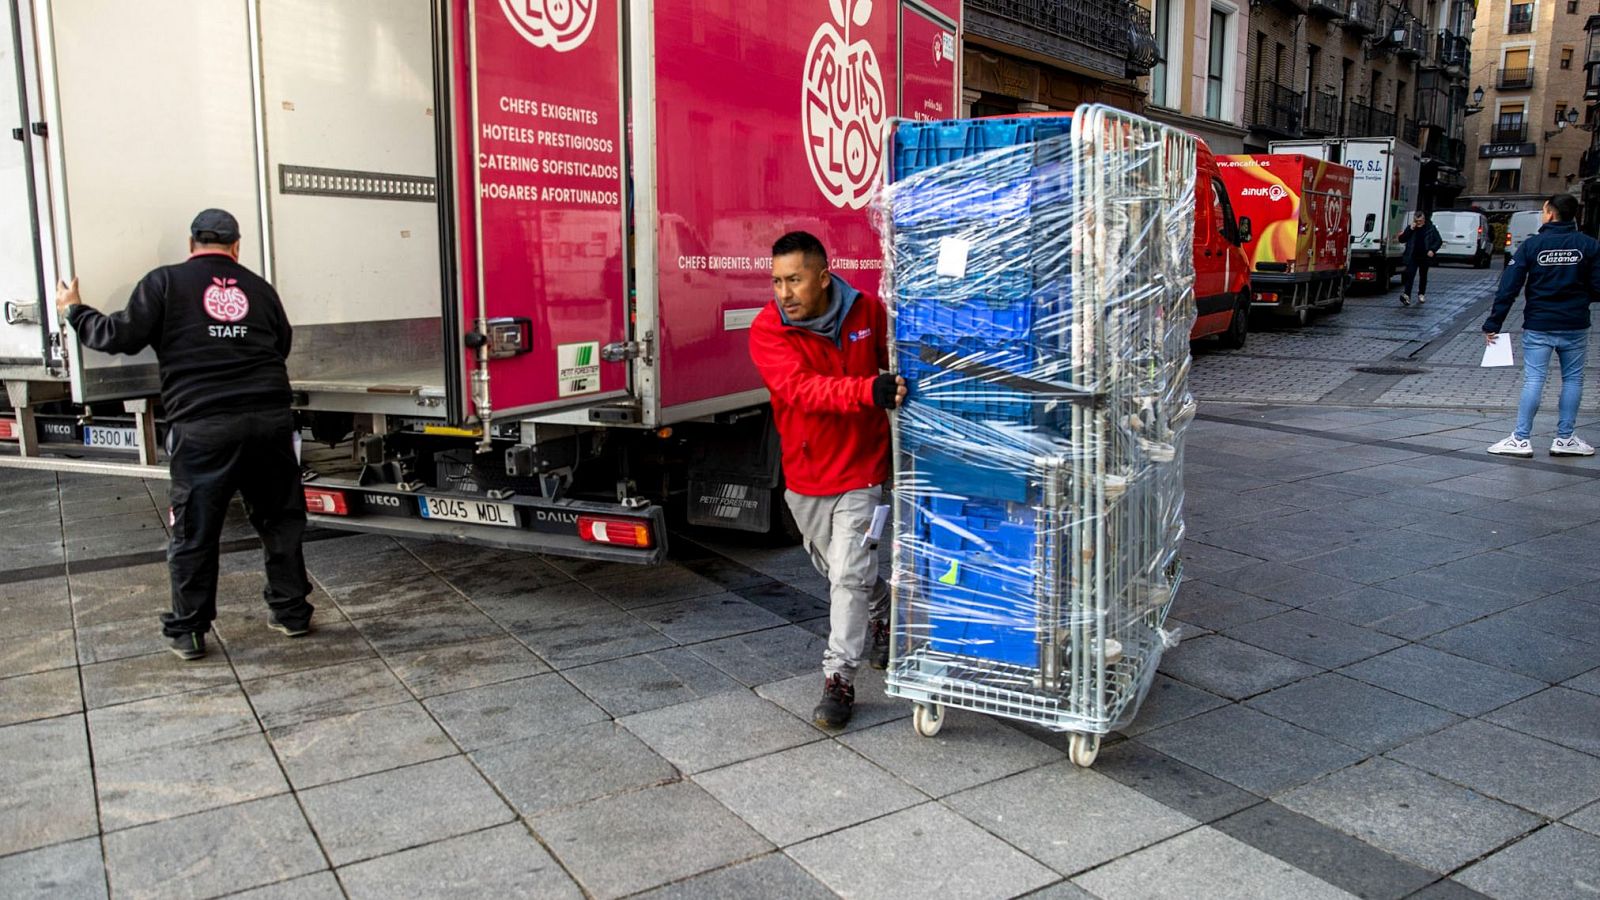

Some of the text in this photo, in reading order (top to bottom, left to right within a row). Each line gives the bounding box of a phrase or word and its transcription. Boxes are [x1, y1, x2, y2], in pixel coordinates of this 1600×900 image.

[807, 33, 883, 130] FRUTAS
[499, 96, 598, 125] CHEFS EXIGENTES
[482, 123, 613, 153] HOTELES PRESTIGIOSOS
[806, 86, 884, 199] ELOY
[479, 152, 619, 179] CATERING SOFISTICADOS
[1367, 160, 1383, 171] S.L.
[480, 182, 618, 205] HOGARES AFORTUNADOS
[678, 255, 773, 271] CHEFS EXIGENTES, HOTE
[831, 258, 882, 270] CATERING SOFISTIC
[208, 325, 248, 338] STAFF
[45, 424, 71, 434] IVECO
[92, 429, 139, 447] 3500 ML
[364, 494, 400, 507] IVECO
[699, 495, 758, 509] PETIT FORESTIER
[430, 498, 508, 524] 3045 MDL
[536, 510, 579, 524] DAILY
